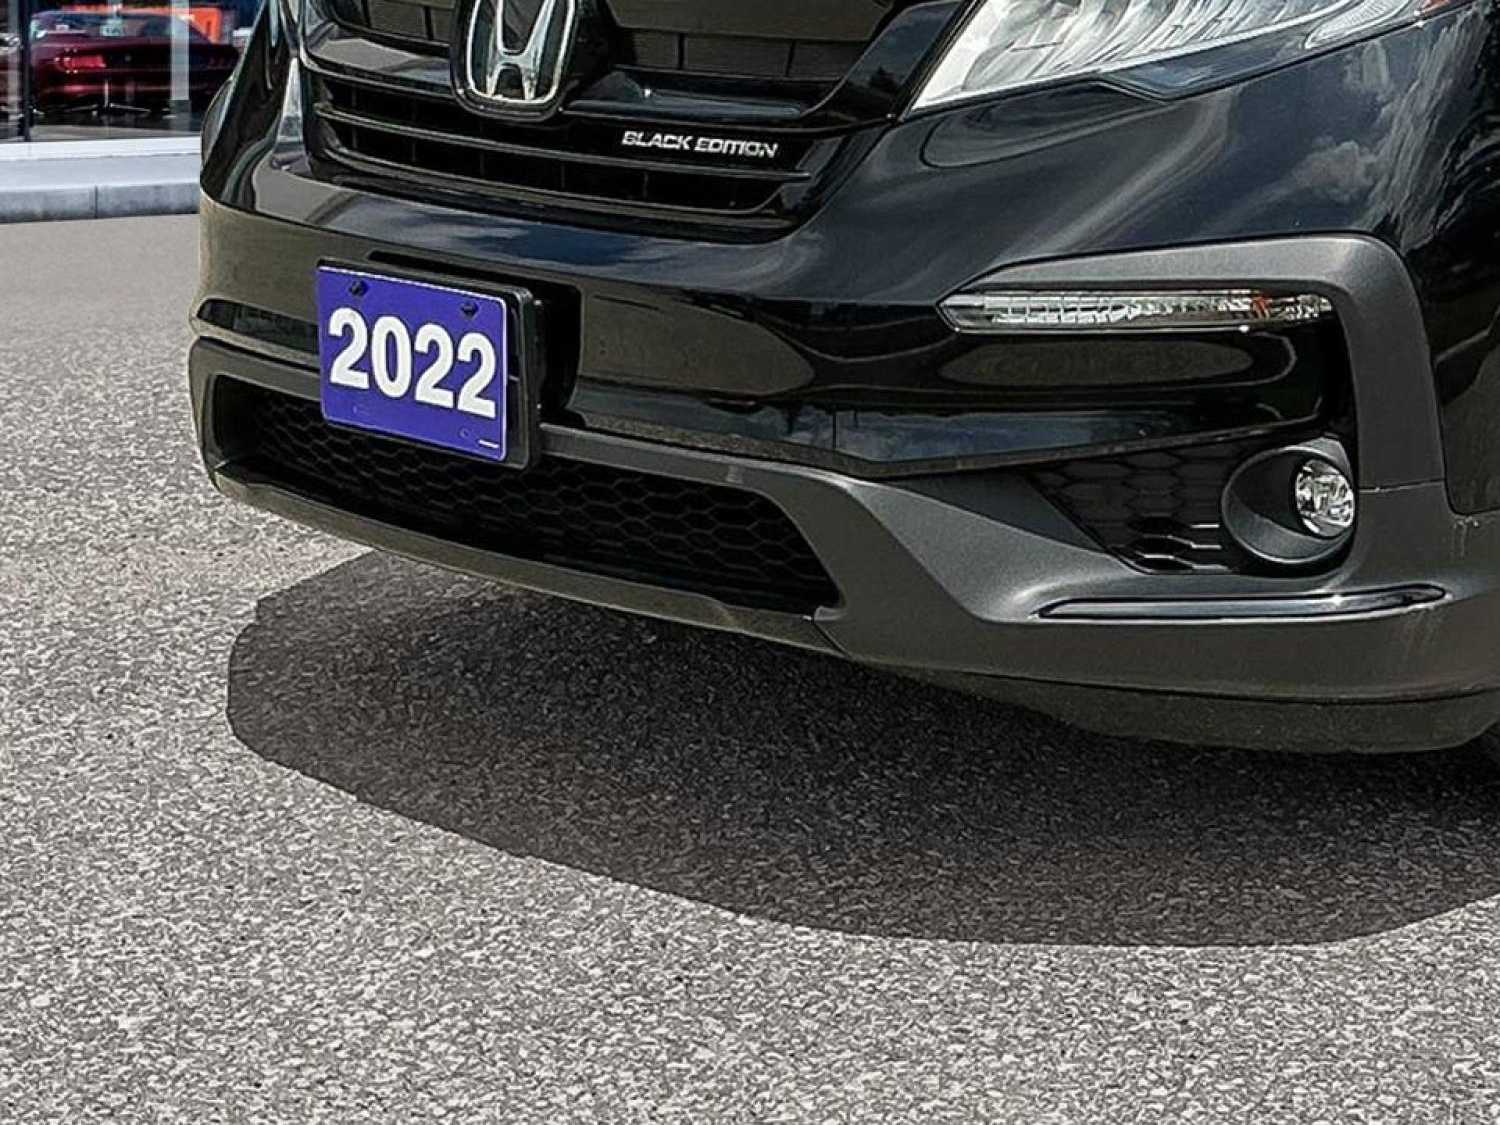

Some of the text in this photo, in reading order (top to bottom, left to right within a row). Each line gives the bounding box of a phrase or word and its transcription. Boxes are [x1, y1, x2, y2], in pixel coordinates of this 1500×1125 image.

[622, 130, 779, 159] BLACK EDITION
[328, 306, 497, 419] 2022
